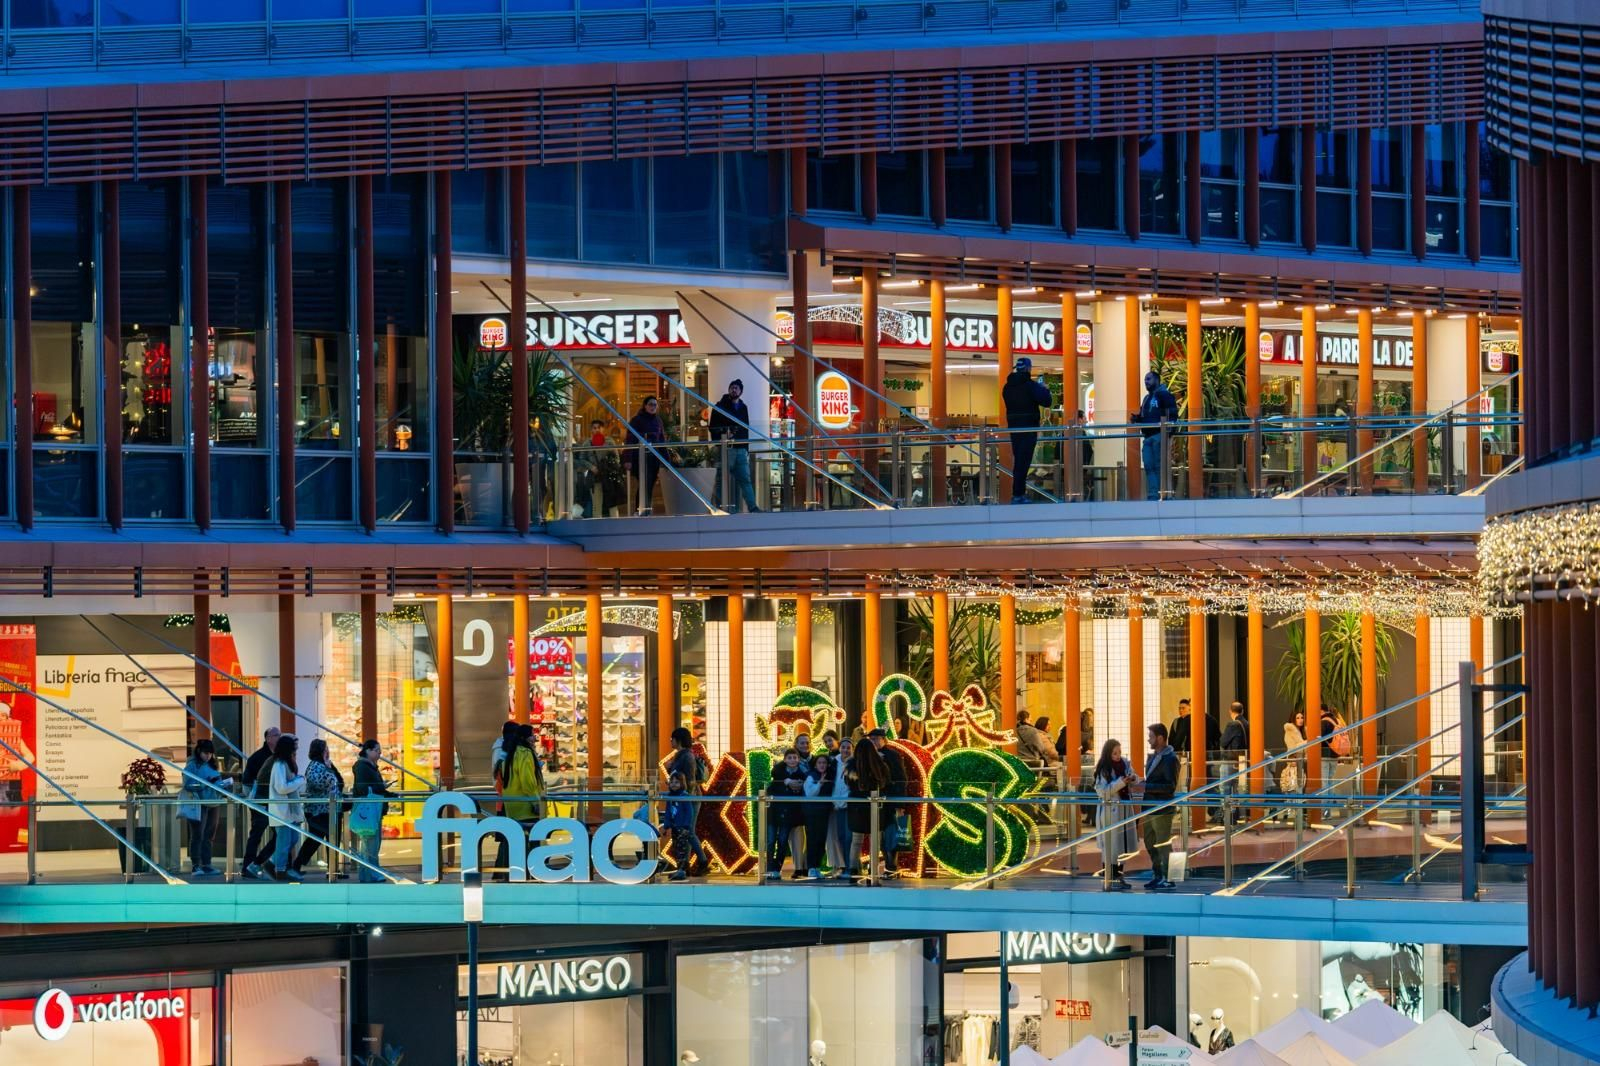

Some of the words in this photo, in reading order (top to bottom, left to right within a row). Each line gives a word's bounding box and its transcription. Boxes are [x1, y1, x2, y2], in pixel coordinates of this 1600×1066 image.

[526, 314, 659, 346] BURGER
[777, 326, 793, 334] ING
[902, 316, 994, 348] BUGER
[1011, 321, 1055, 351] ING
[1322, 336, 1391, 366] PARRLA
[821, 391, 849, 401] BURGER
[821, 401, 849, 415] KING
[44, 670, 100, 684] Librería
[105, 667, 147, 683] fnac
[415, 791, 660, 885] fnac
[1006, 931, 1116, 960] MANGO
[499, 957, 631, 999] MANGO
[79, 992, 185, 1023] vodafone
